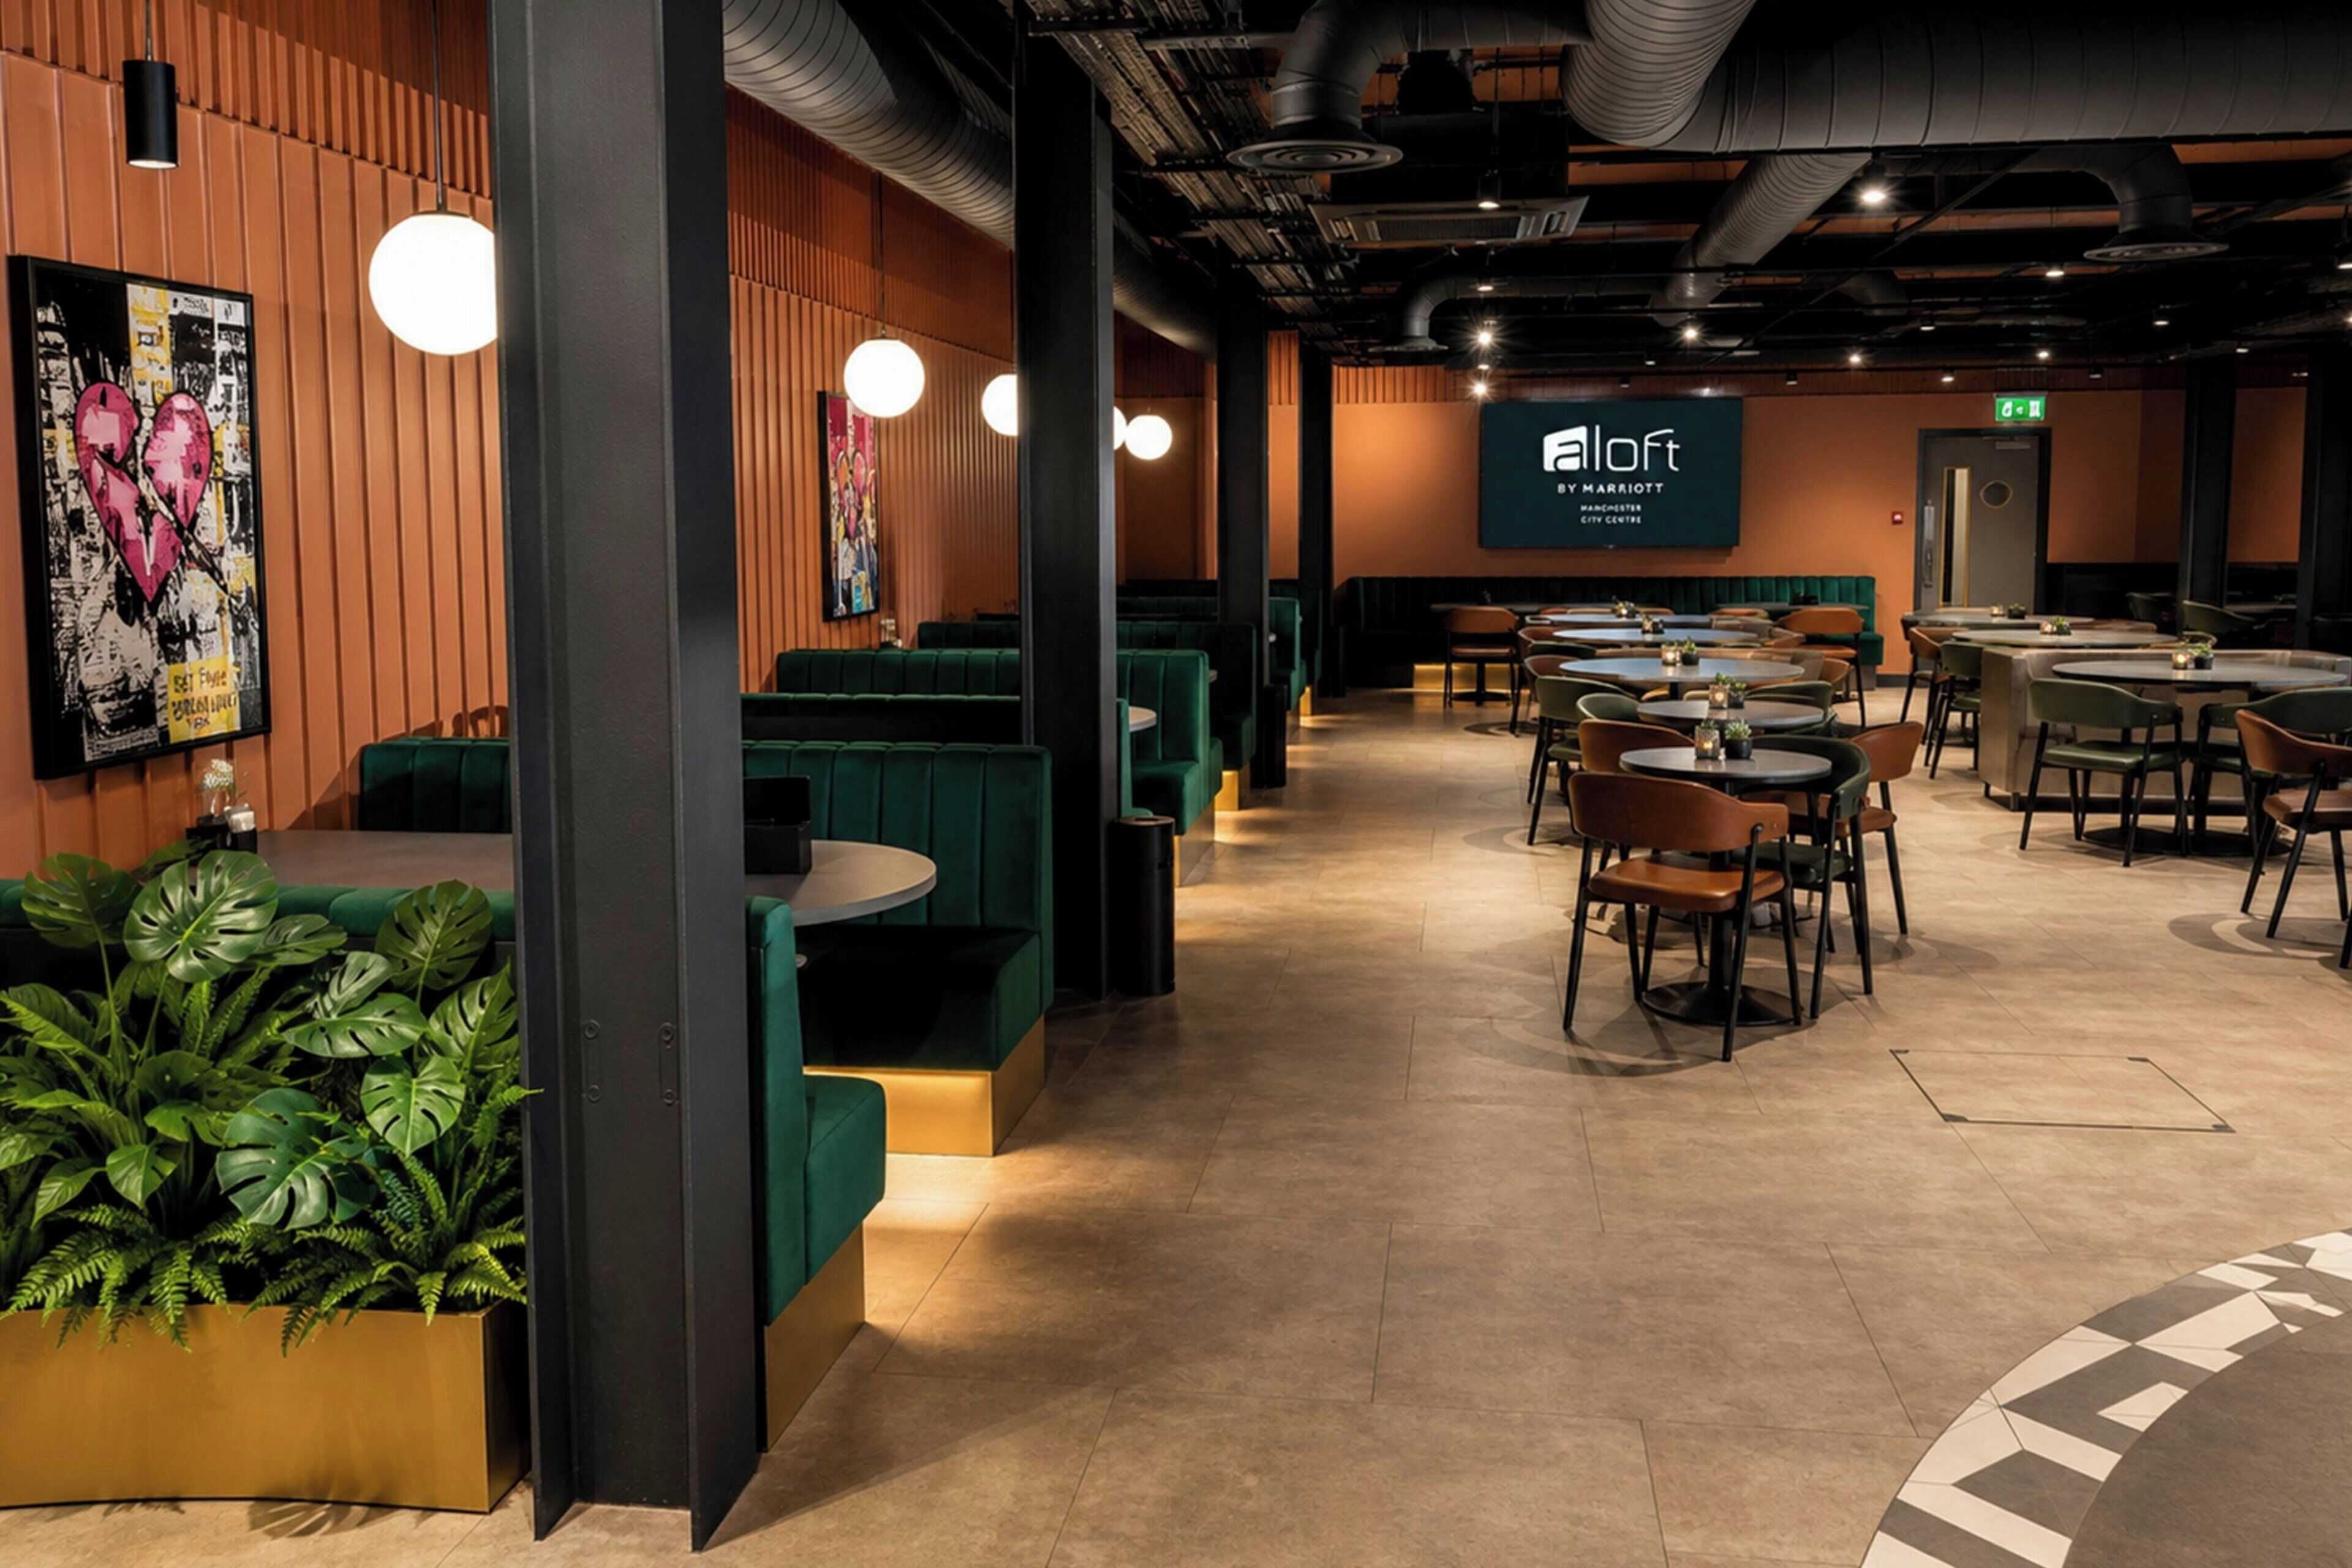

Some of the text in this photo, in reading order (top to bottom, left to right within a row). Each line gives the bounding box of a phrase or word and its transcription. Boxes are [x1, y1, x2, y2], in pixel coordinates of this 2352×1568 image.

[1544, 424, 1680, 472] aloft
[1558, 483, 1663, 494] BY MARRIOTT
